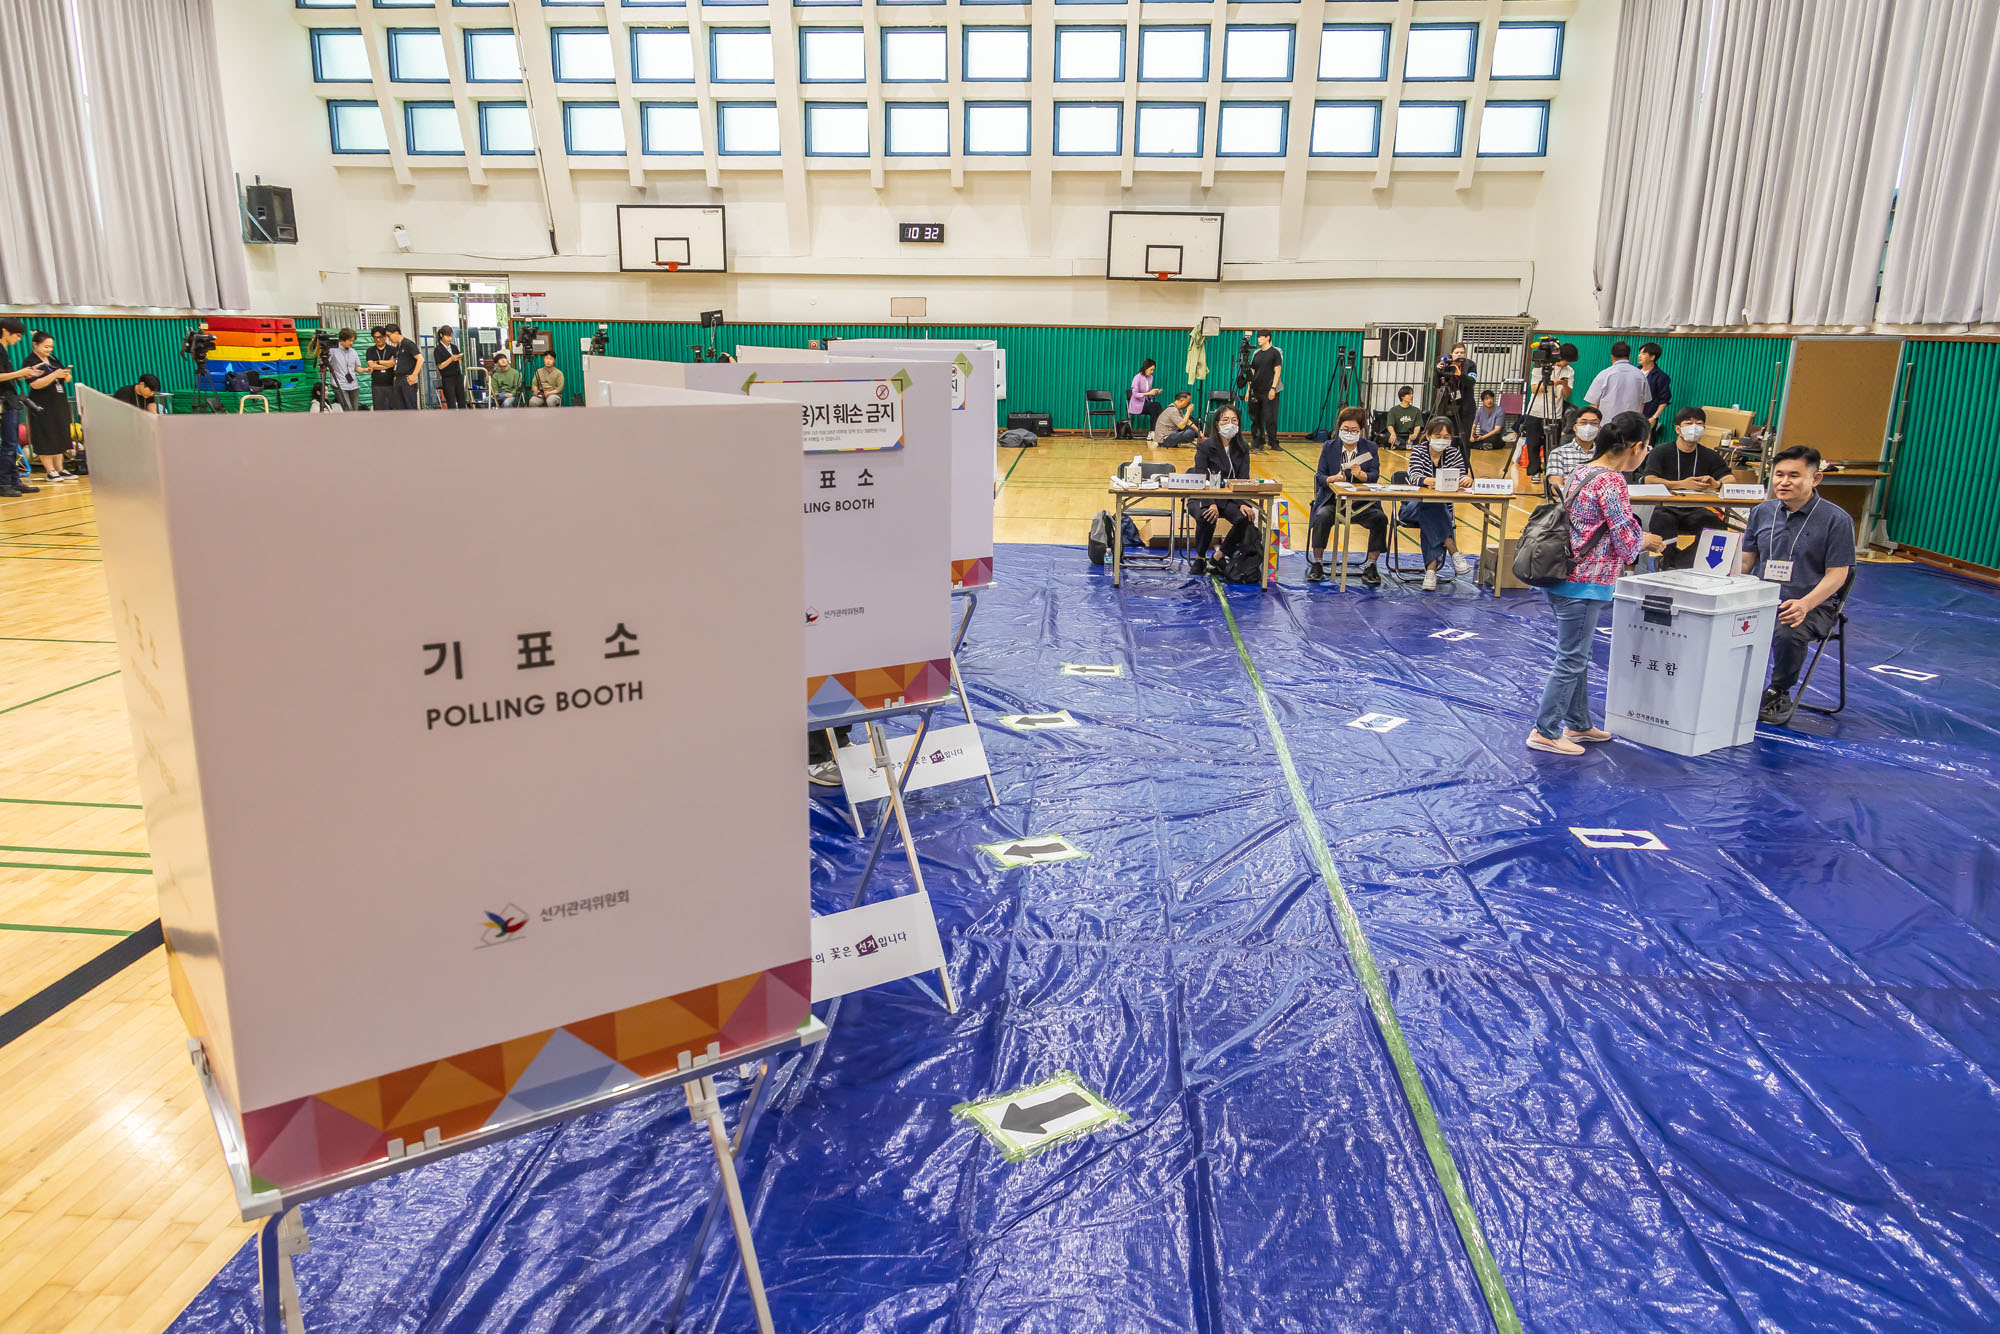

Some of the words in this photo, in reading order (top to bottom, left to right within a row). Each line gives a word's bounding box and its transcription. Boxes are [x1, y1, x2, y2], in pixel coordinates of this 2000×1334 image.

[833, 403, 864, 424] 훼손
[866, 402, 895, 423] 금지
[835, 498, 875, 511] BOOTH
[824, 606, 865, 619] 선거관리위원회
[426, 694, 546, 730] POLLING
[556, 680, 643, 712] BOOTH
[539, 889, 630, 923] 선거관리위원회
[829, 946, 853, 961] 꽃은
[857, 931, 908, 955] 선거입니다
